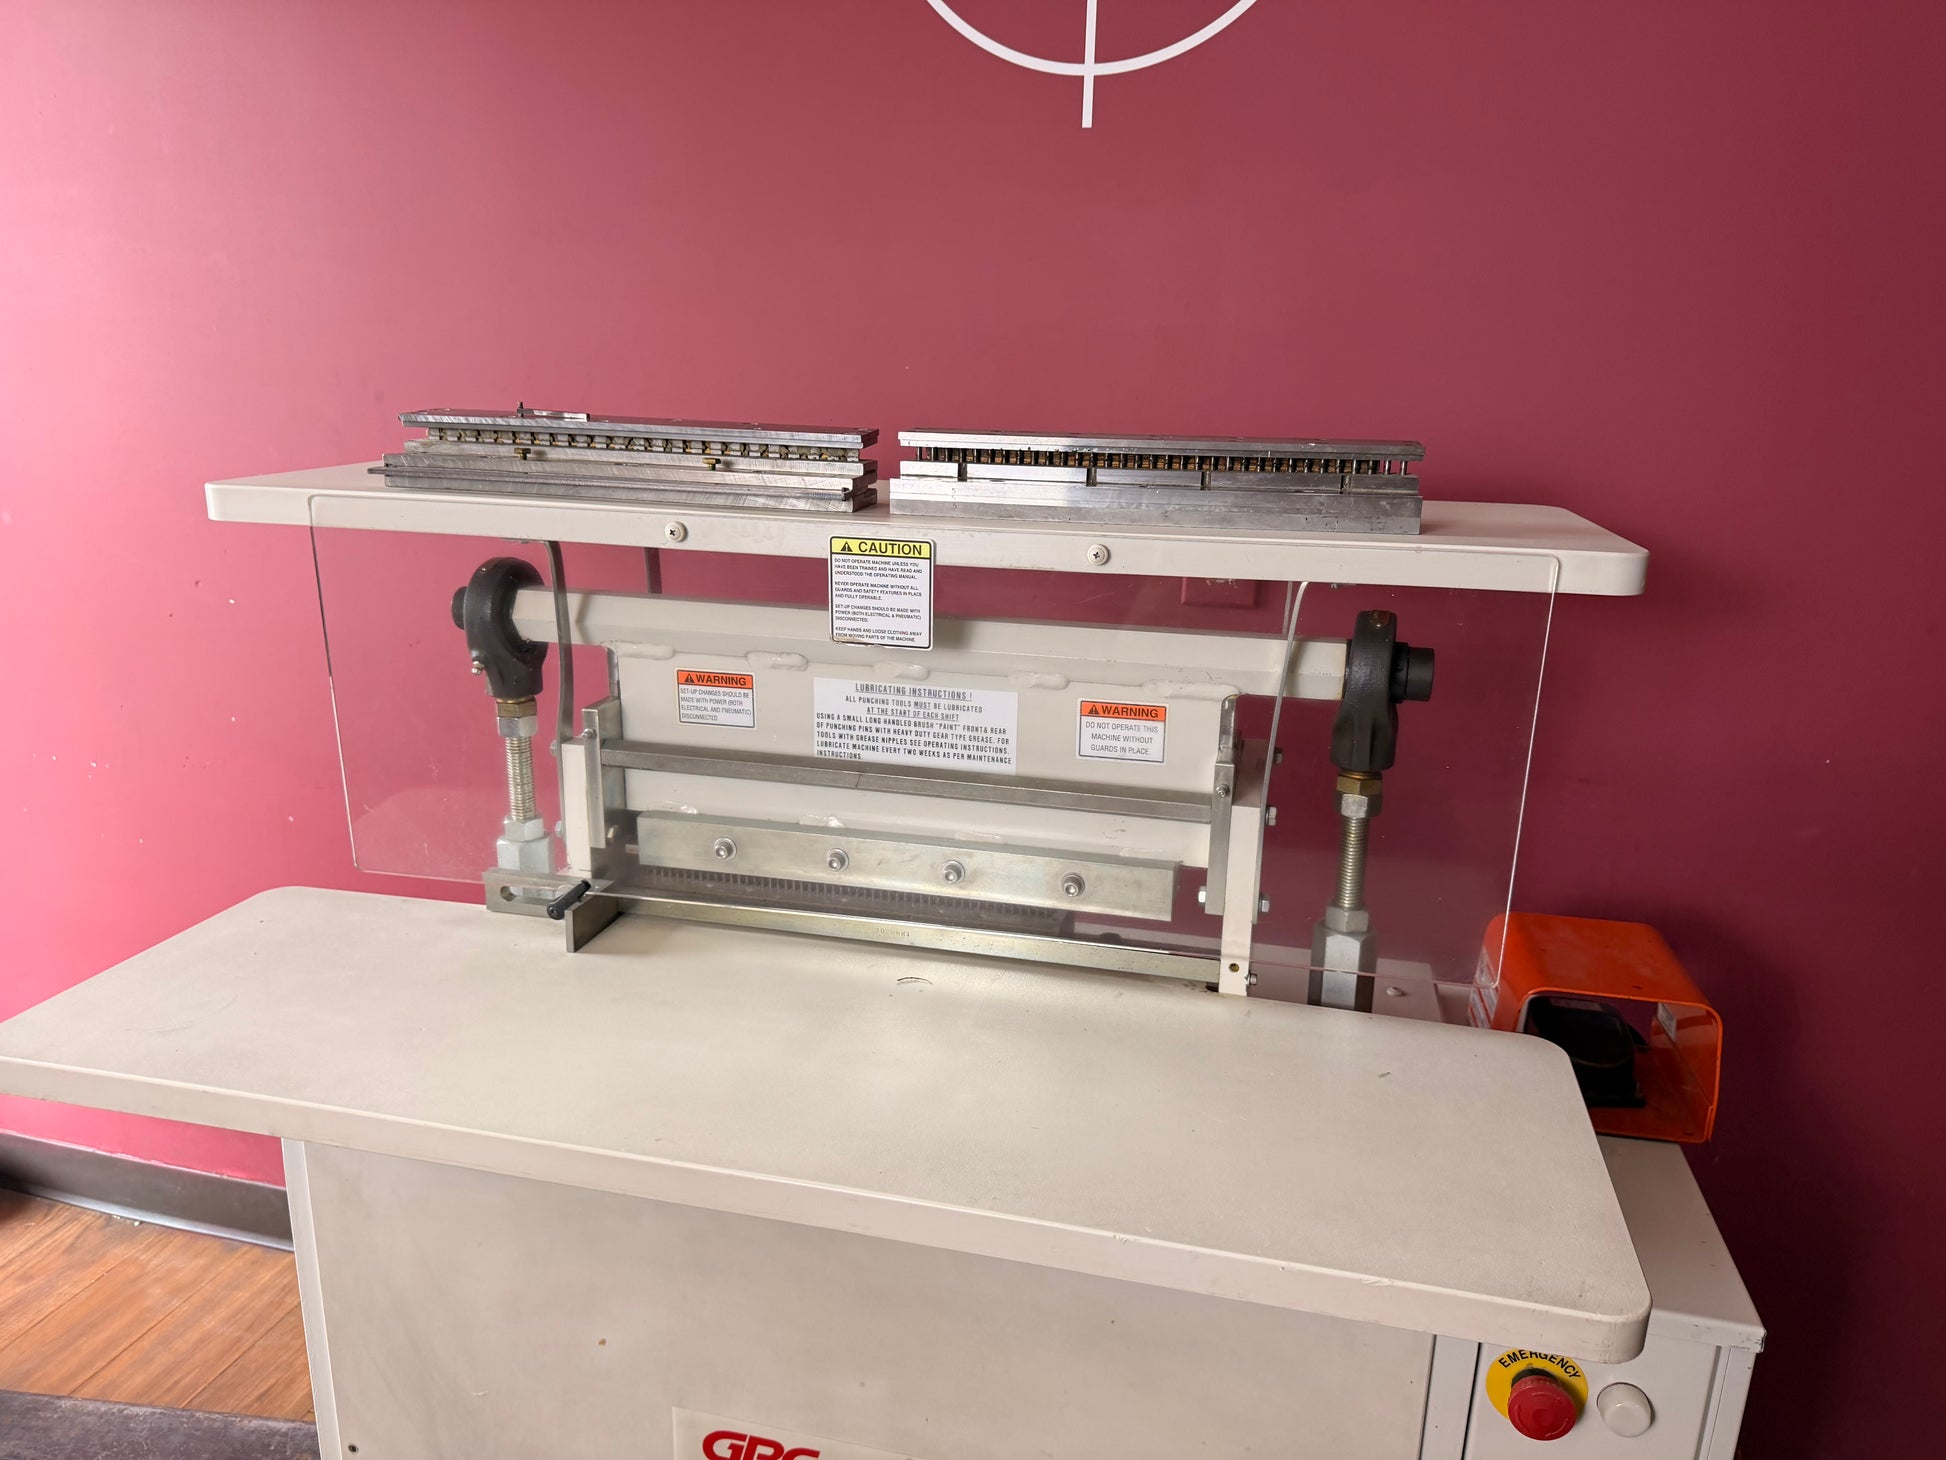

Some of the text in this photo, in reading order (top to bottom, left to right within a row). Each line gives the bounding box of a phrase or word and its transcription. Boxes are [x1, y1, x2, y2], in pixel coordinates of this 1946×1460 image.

[859, 542, 922, 555] CAUTION
[696, 674, 746, 686] WARNING
[856, 683, 906, 694] LUBRICATING
[909, 688, 966, 700] INSTRUCTIONS
[859, 697, 889, 706] PUNCHING
[892, 699, 911, 707] TOOLS
[944, 704, 982, 713] LUBRICATED
[941, 713, 959, 721] SHIFT
[1102, 706, 1158, 718] WARNING
[884, 718, 911, 727] HANDLED
[990, 727, 1006, 735] REAR
[1112, 724, 1141, 732] OPERATE
[826, 723, 856, 731] PUNCHING
[915, 730, 930, 738] DUTY
[969, 735, 995, 743] GREASE.
[1091, 733, 1153, 744] MACHINE WITHOUT
[856, 735, 879, 743] GREASE
[882, 737, 907, 745] NIPPLES
[923, 741, 958, 750] OPERATING
[961, 744, 1009, 754] INSTRUCTIONS.
[1091, 744, 1118, 752] GUARDS
[817, 741, 850, 749] LUBRICATE
[852, 744, 879, 752] MACHINE
[904, 748, 916, 756] TWO
[967, 754, 1012, 764] MAINTENANCE
[817, 750, 863, 760] INSTRUCTIONS.
